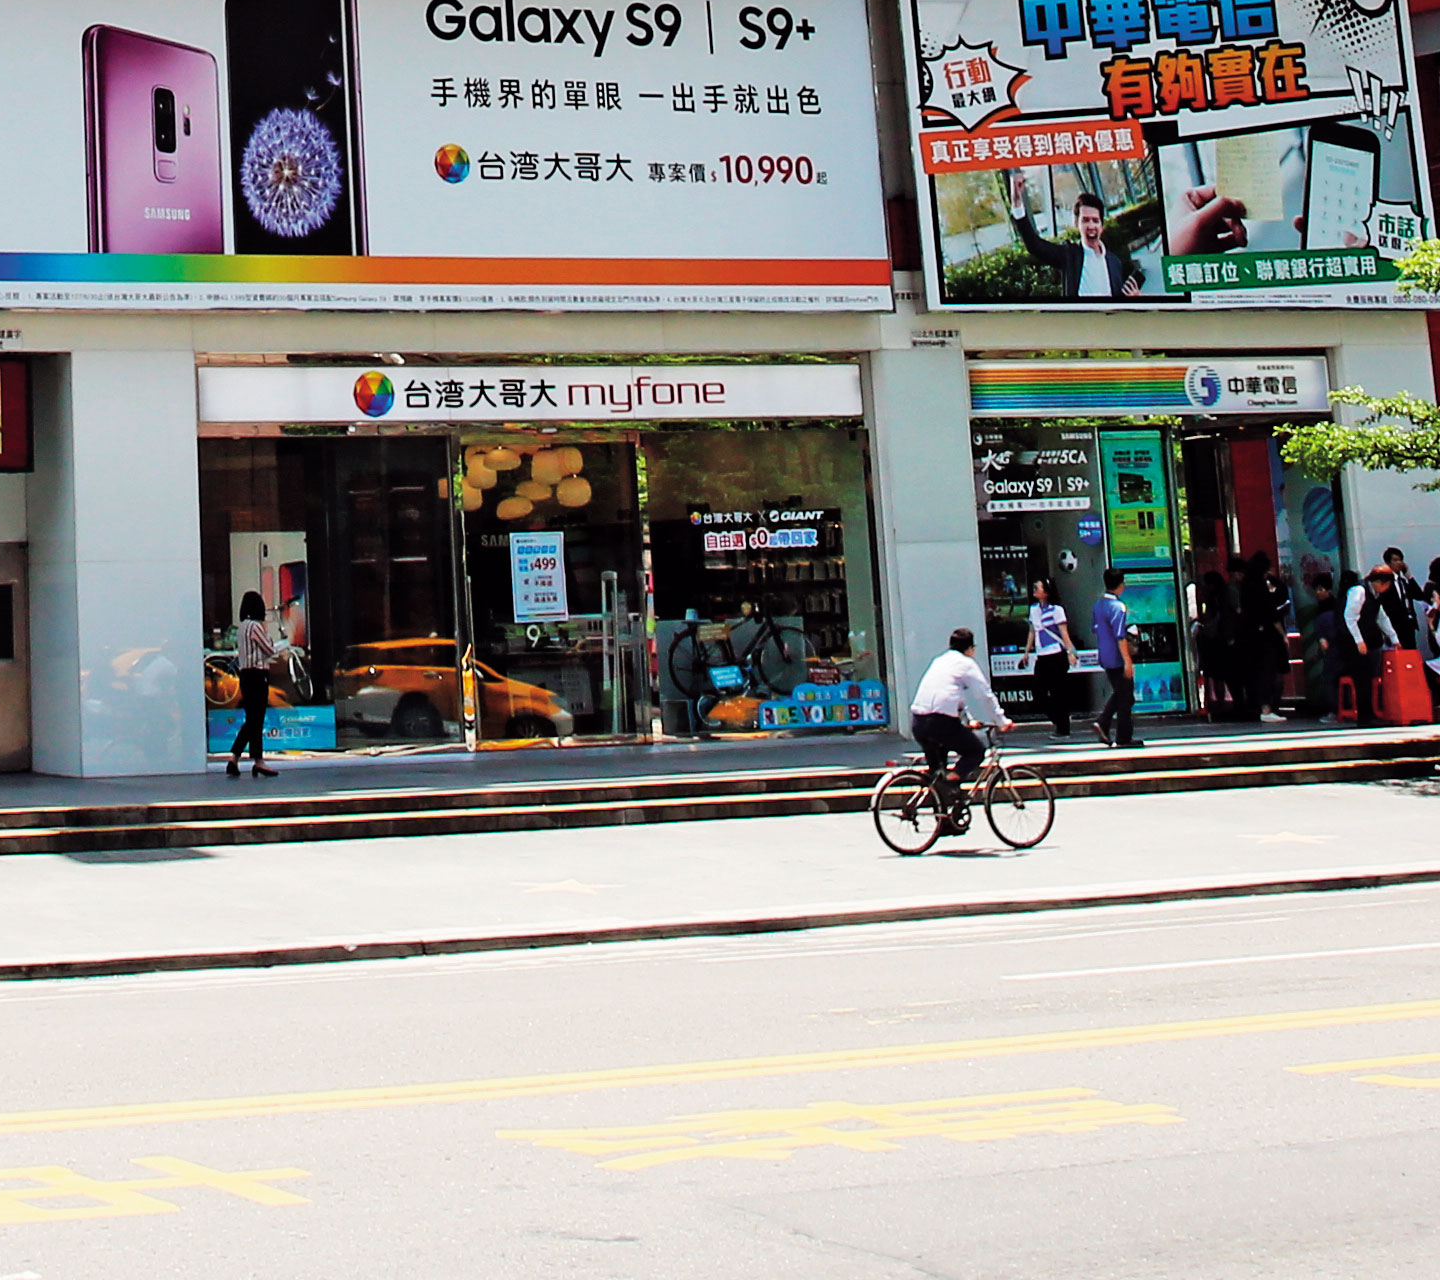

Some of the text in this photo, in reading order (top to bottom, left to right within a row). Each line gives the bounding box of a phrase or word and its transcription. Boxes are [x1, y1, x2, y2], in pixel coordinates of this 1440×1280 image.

[625, 2, 681, 46] S9
[739, 6, 816, 52] S9+
[943, 57, 992, 90] 行動
[1103, 42, 1306, 118] 有夠實在
[429, 76, 823, 116] 手機界的單眼 一出手就出色
[952, 86, 996, 109] 最大網
[929, 127, 1136, 165] 真正享受得到網內優惠
[143, 206, 190, 222] SAMSUNG
[1378, 213, 1415, 239] 市話
[1167, 254, 1377, 286] 餐廳訂位、聯繫銀行超實用
[567, 376, 726, 414] myfone
[1227, 376, 1298, 396] 中華電信
[983, 476, 1090, 497] Galaxy S9 S9+
[780, 511, 824, 521] GIANT
